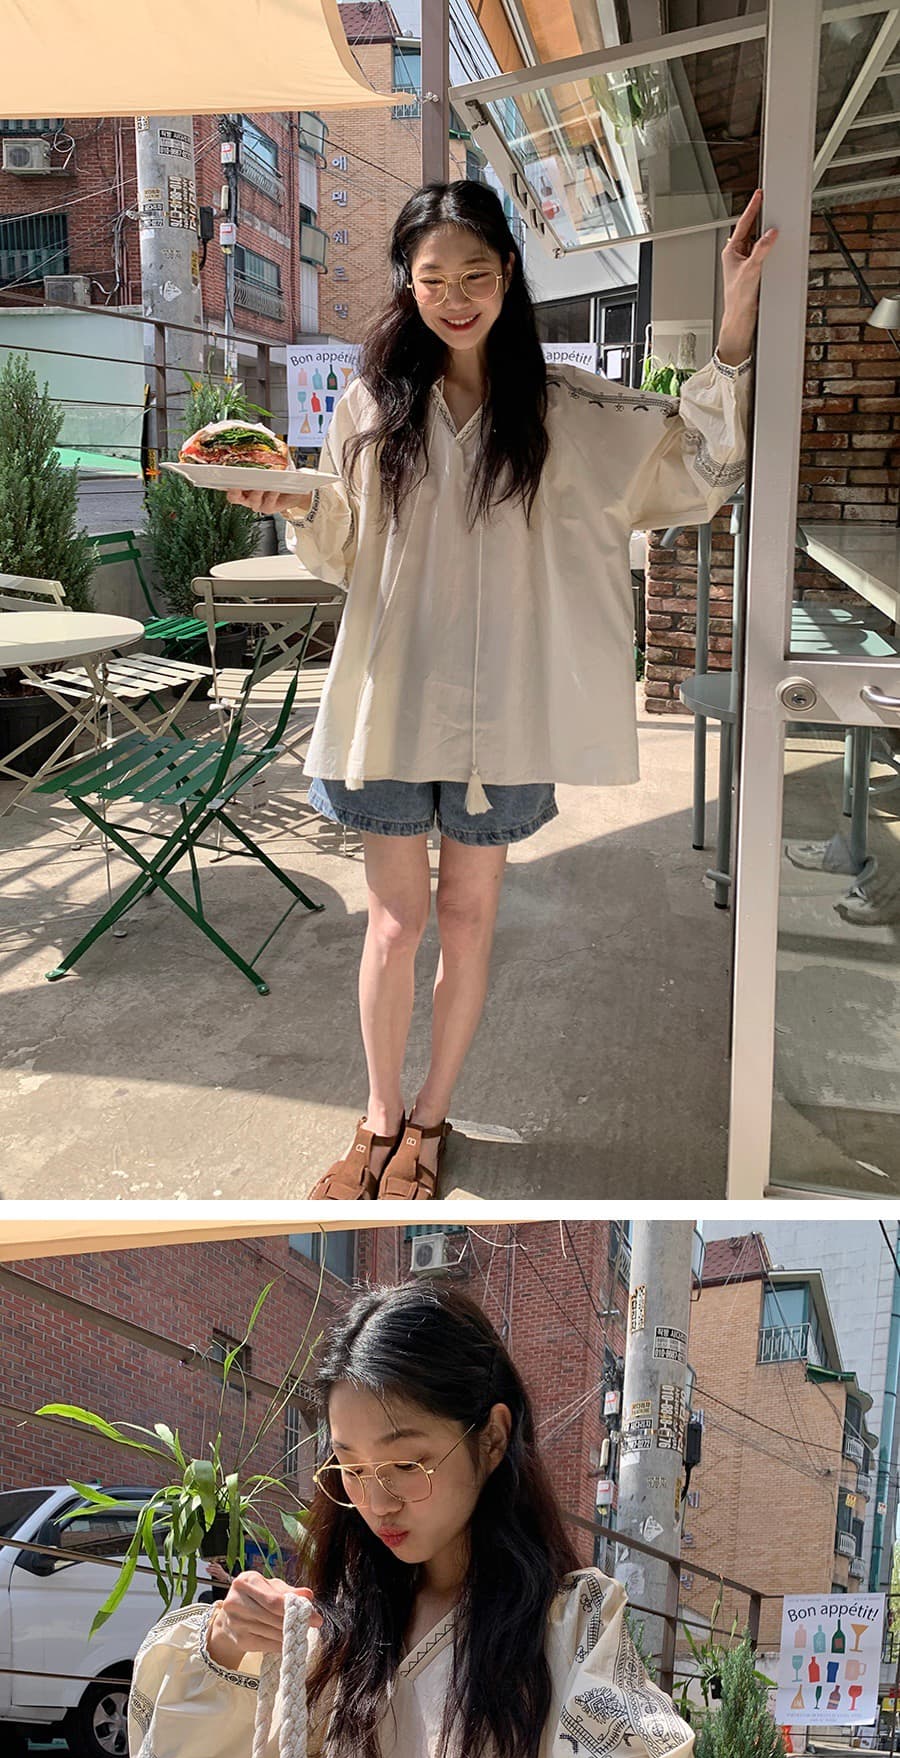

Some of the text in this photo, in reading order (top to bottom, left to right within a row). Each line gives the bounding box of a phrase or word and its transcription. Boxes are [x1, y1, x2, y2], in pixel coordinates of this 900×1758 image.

[290, 353, 313, 367] Bon
[546, 350, 592, 365] appétit!
[787, 1602, 879, 1623] Bon appétit!
